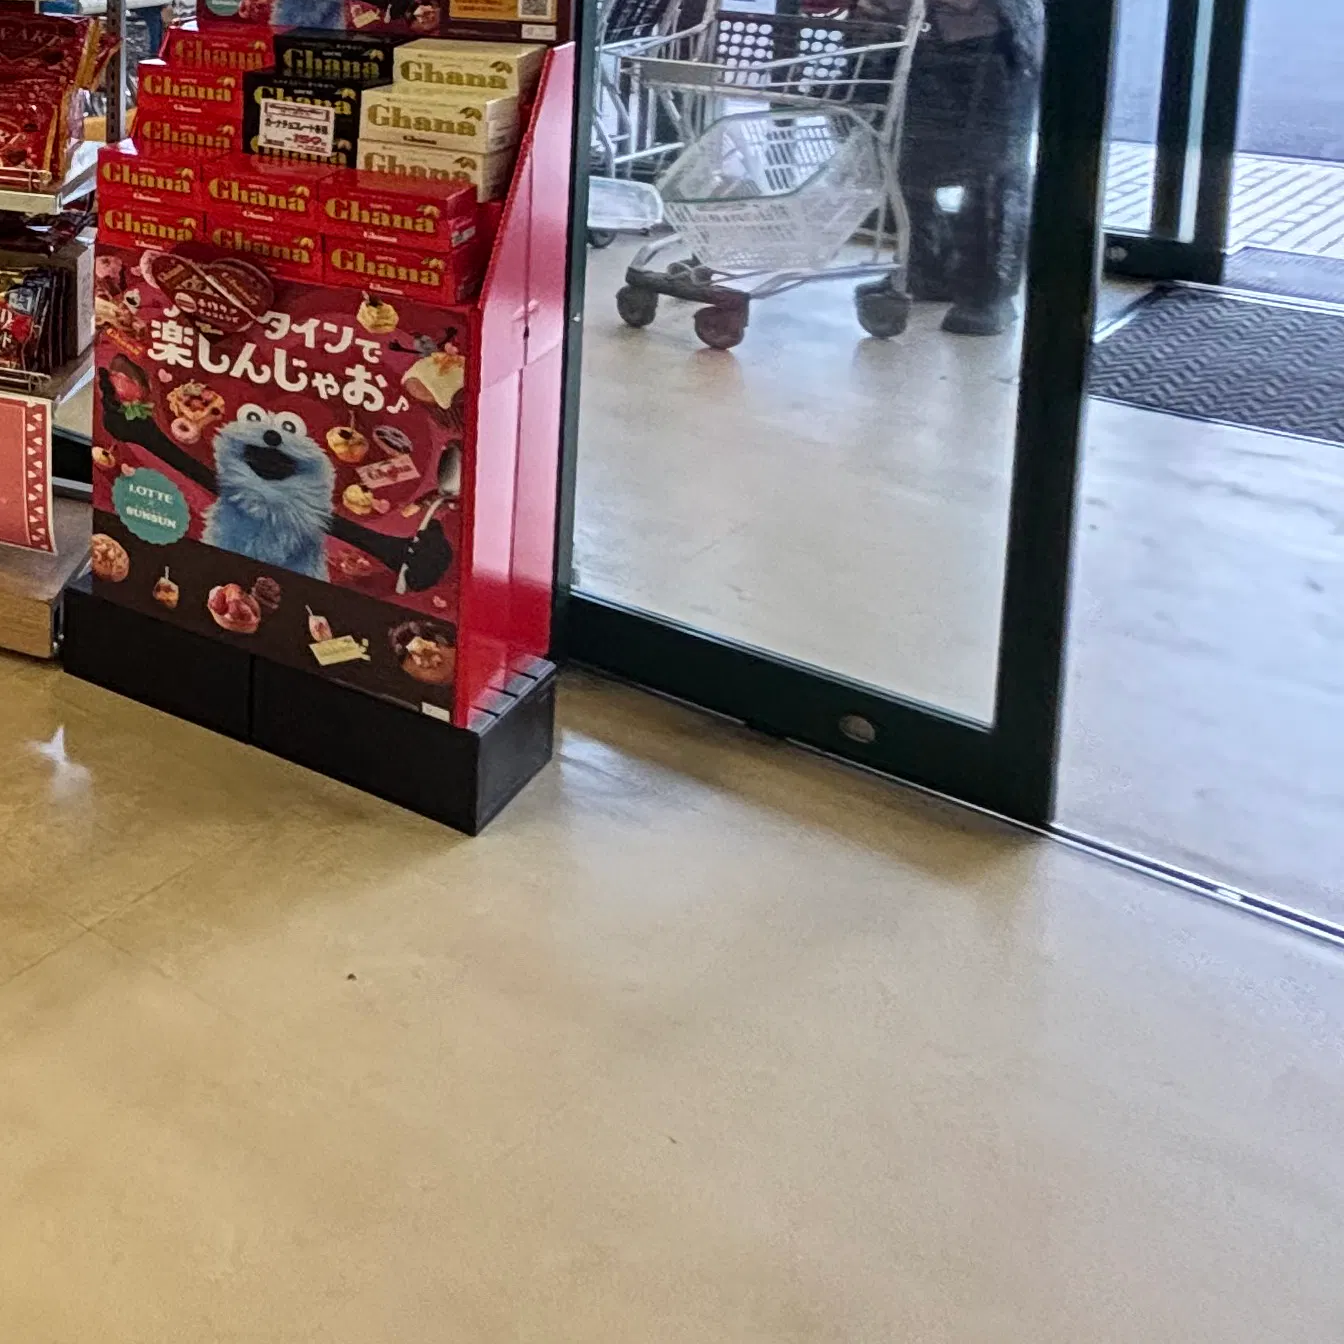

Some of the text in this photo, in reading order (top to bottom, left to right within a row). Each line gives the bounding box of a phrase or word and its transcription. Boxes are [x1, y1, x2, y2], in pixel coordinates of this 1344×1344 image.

[142, 75, 233, 103] Ghana
[399, 60, 508, 90] Ghana
[365, 104, 478, 137] Ghana
[102, 160, 192, 194] Ghana
[209, 177, 308, 213] Ghana
[103, 209, 194, 241] Ghana
[324, 199, 435, 234] Ghana
[330, 248, 442, 287] Ghana
[128, 483, 175, 505] LOTTE
